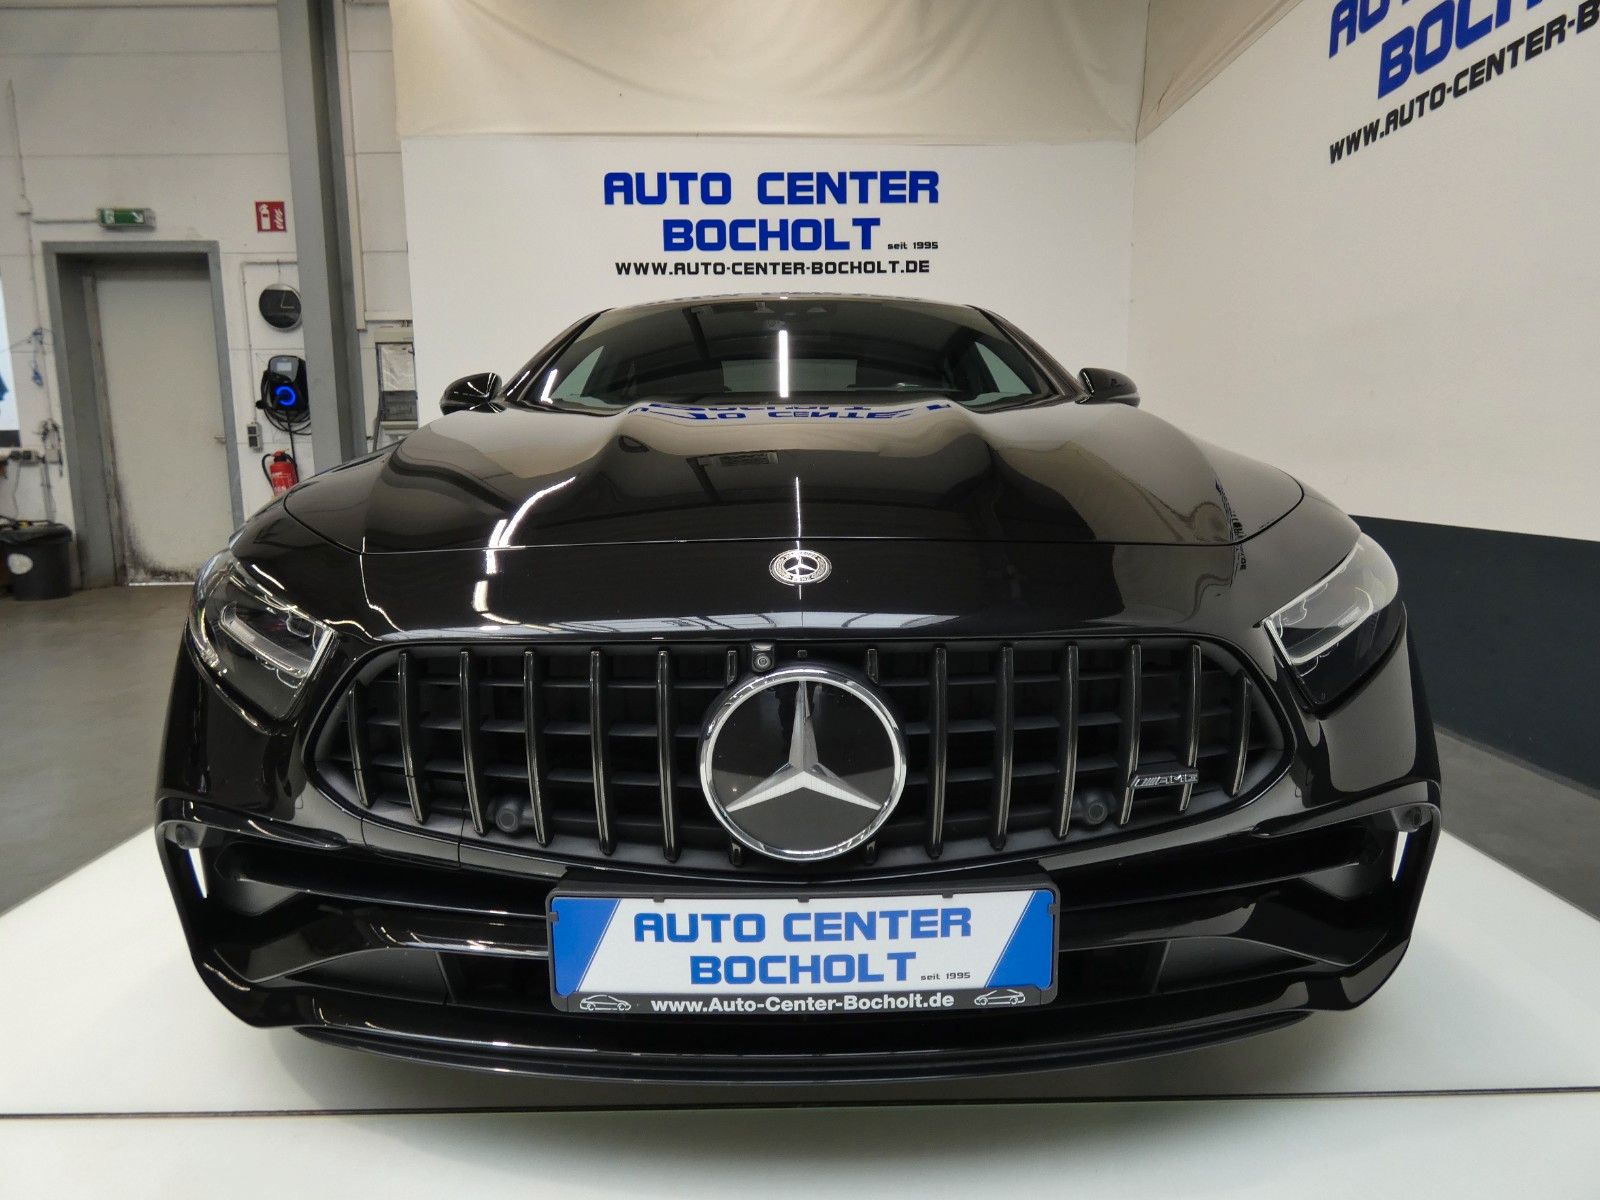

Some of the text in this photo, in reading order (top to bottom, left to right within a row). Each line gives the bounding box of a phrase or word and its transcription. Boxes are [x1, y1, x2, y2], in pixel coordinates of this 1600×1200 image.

[603, 170, 939, 205] AUTO CENTER
[662, 217, 939, 252] BOCHOLT seit 1995
[615, 259, 930, 276] WWW.AUTO-CENTER-BOCHOLT.DE
[633, 906, 972, 943] AUTO CENTER
[690, 951, 971, 986] BOCHOLT seit 1995
[650, 992, 955, 1013] www.Auto-Center-Bocholt.de
